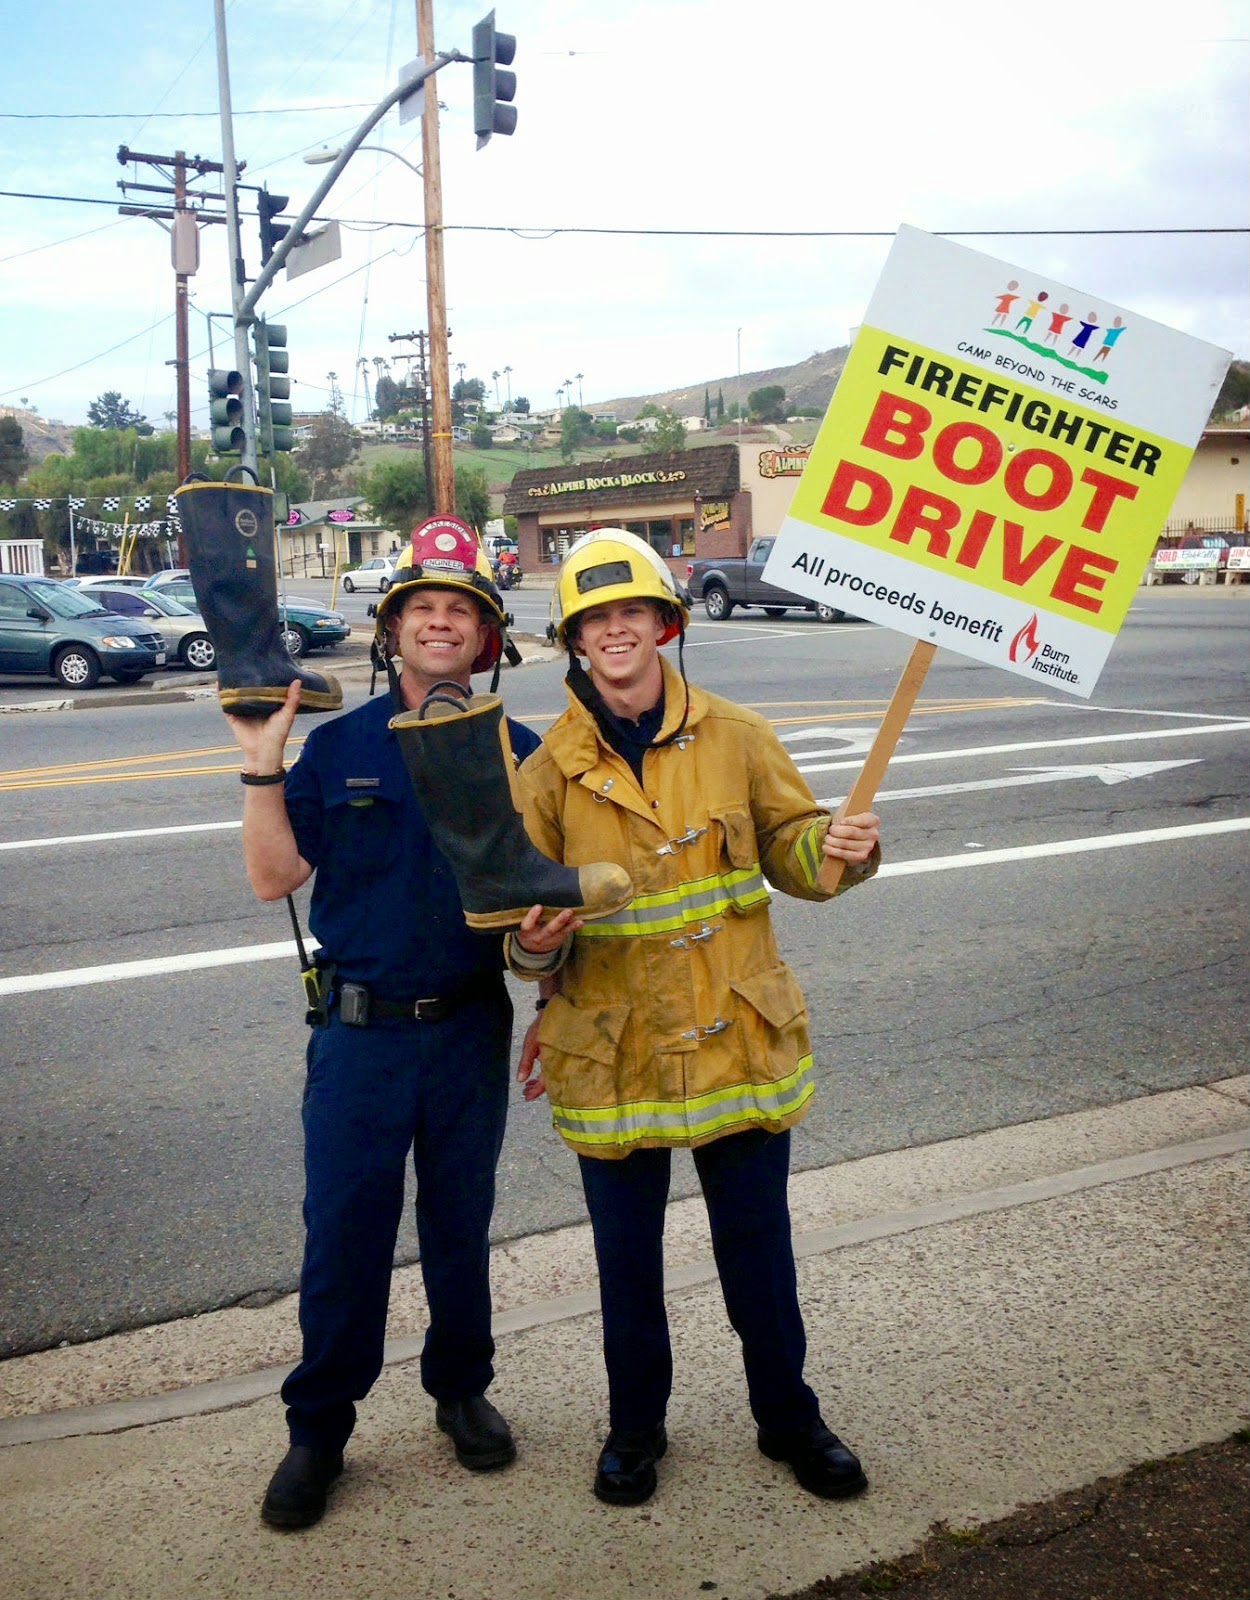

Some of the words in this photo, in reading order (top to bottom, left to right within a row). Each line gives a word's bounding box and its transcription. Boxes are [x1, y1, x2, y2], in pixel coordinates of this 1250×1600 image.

[957, 341, 991, 360] CAMP
[995, 355, 1045, 382] BEYOND
[1051, 375, 1075, 394] THE
[1078, 388, 1118, 410] SCARS
[877, 345, 1163, 476] FIREFIGHTER
[550, 480, 585, 494] ALPINE
[586, 477, 614, 490] ROCK
[620, 471, 657, 486] BLOCK
[860, 390, 1140, 534] BOOT
[820, 459, 1120, 614] DRIVE
[1158, 551, 1177, 562] SOLD
[424, 559, 464, 569] ENGINEER
[792, 552, 825, 578] All
[824, 566, 926, 615] proceeds
[929, 601, 1003, 643] benefit
[1031, 657, 1079, 684] Institute
[1041, 644, 1070, 664] Burn
